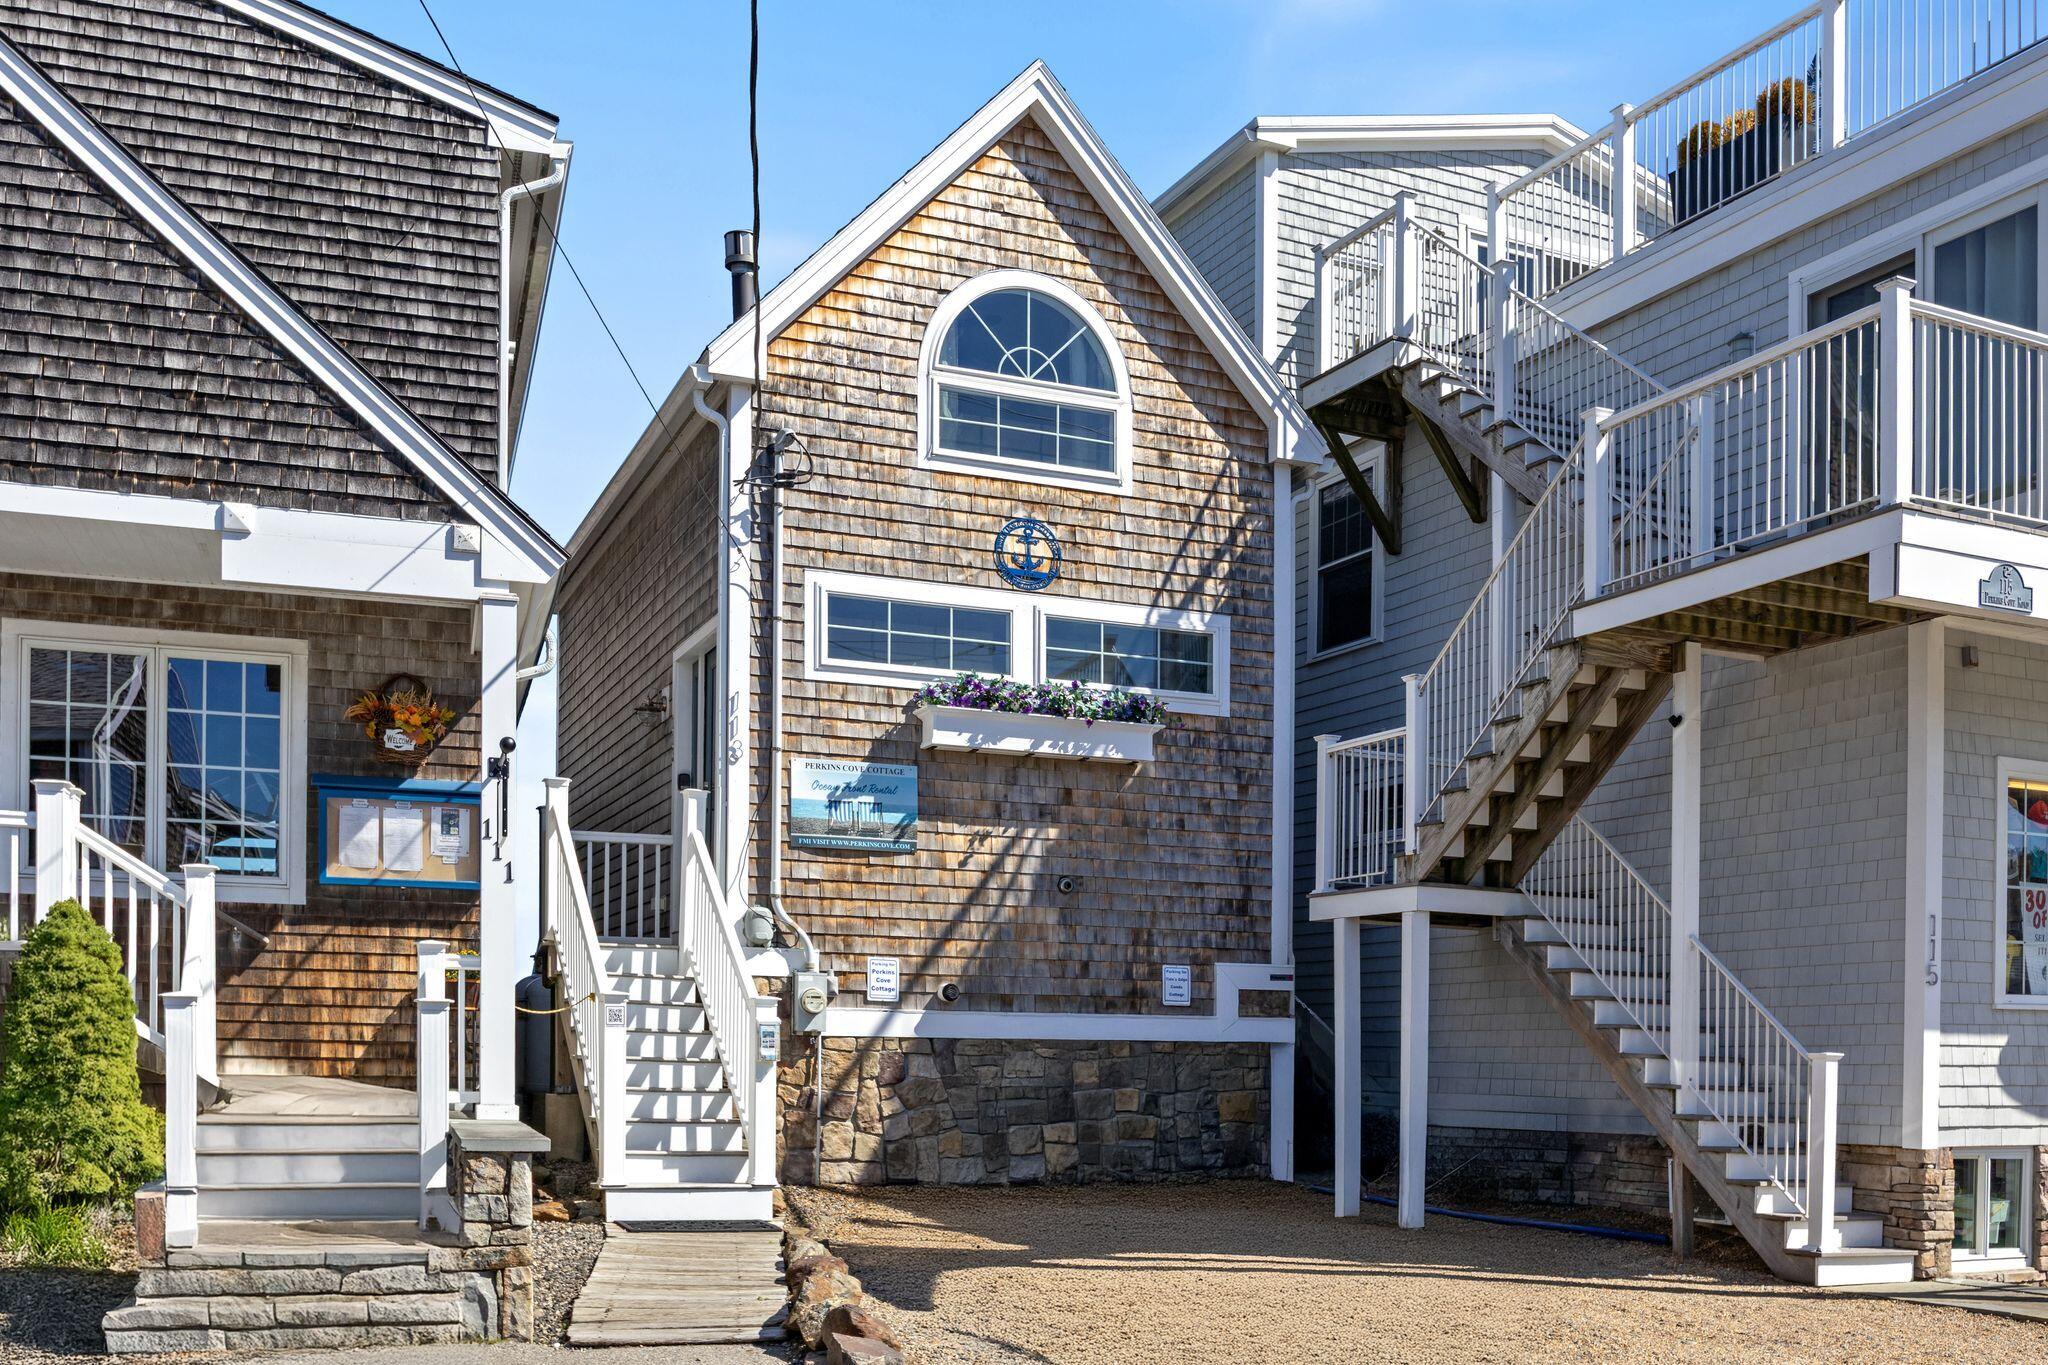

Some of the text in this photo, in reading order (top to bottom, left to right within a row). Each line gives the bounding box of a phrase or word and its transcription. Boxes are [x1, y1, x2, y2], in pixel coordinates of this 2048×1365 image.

[1999, 579, 2013, 595] 115
[805, 762, 905, 776] PERKINS COVE COTTAGE
[811, 779, 898, 795] Ocean Front Rental
[831, 839, 911, 850] WWW.PERKINSCOVE.COM
[871, 985, 896, 993] Cottage
